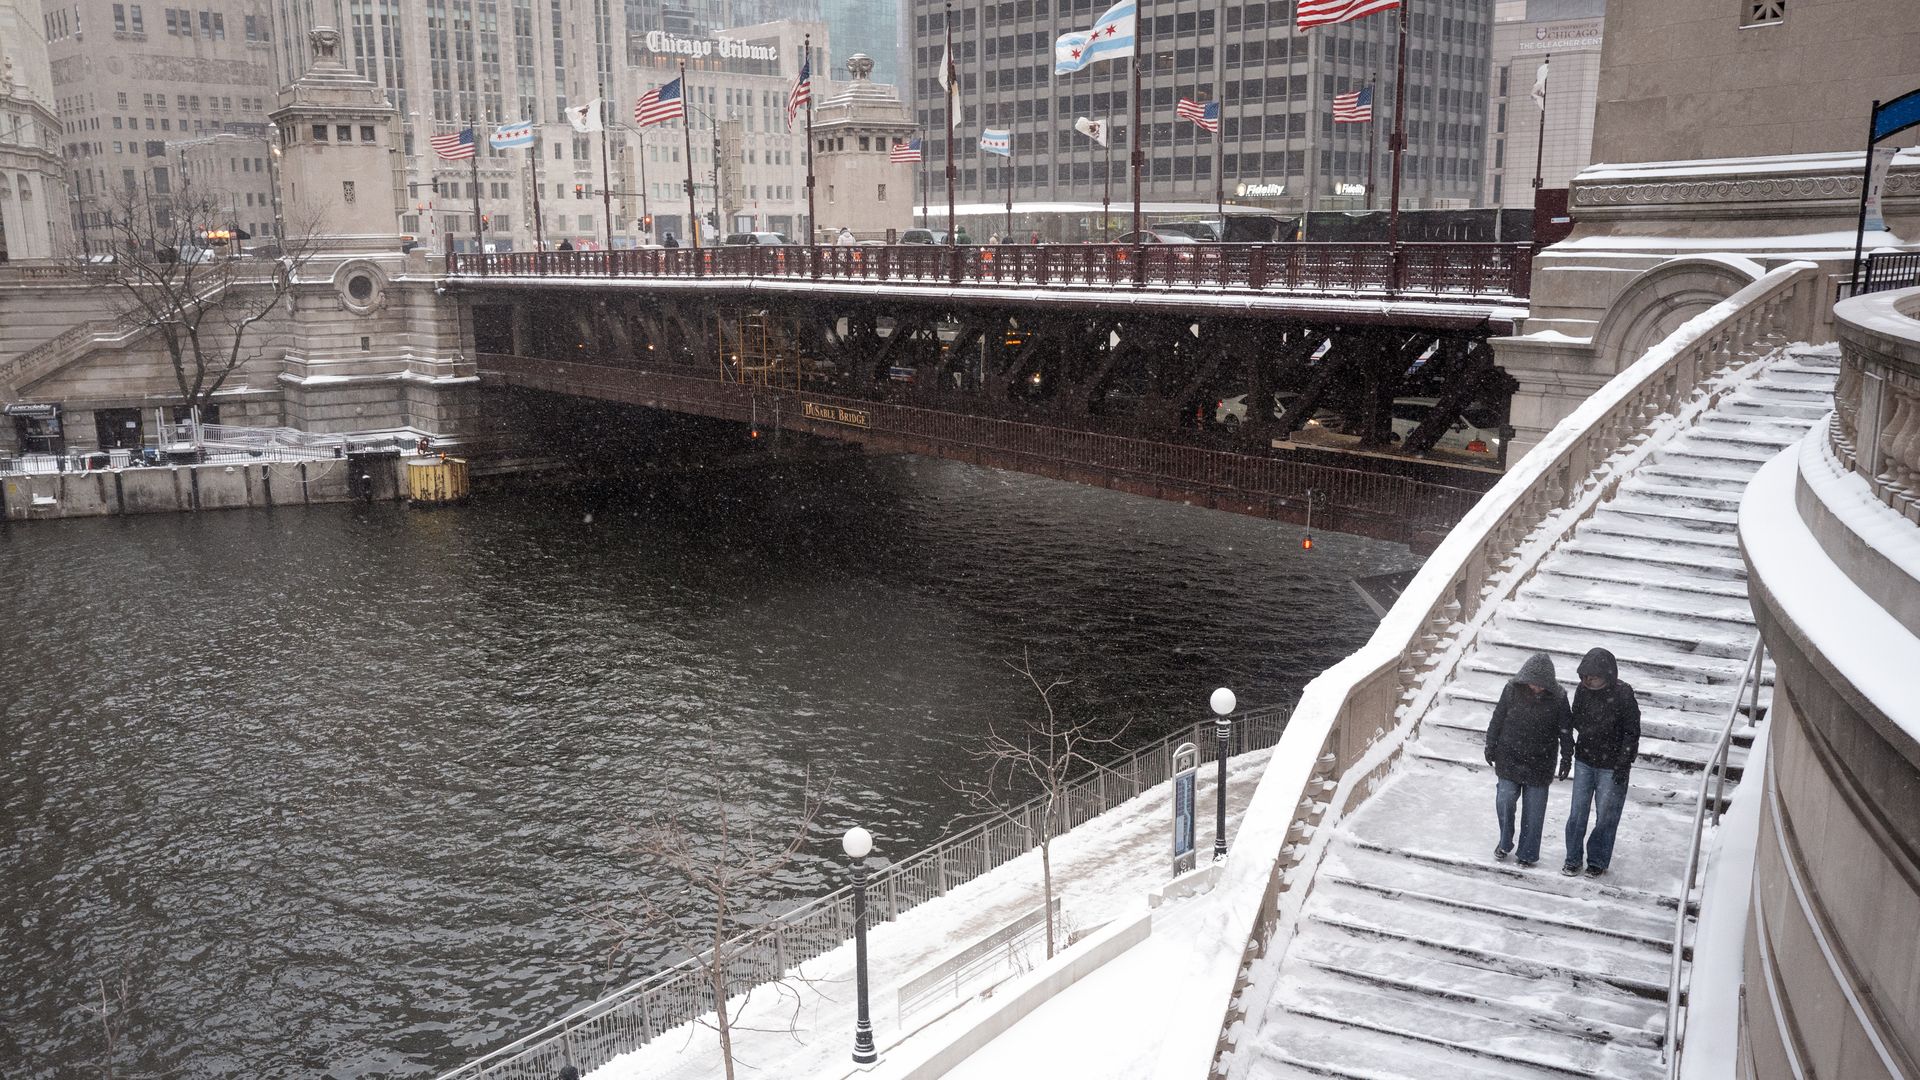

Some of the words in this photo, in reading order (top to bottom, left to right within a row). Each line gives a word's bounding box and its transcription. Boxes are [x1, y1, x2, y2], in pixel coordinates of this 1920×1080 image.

[1548, 28, 1598, 39] CHICAGO
[646, 30, 711, 58] Chicago
[718, 36, 777, 61] Tribune
[1519, 42, 1535, 50] THE
[1246, 184, 1285, 196] Fidelity
[1342, 183, 1366, 196] Fidelity
[838, 408, 867, 425] BRIDGE
